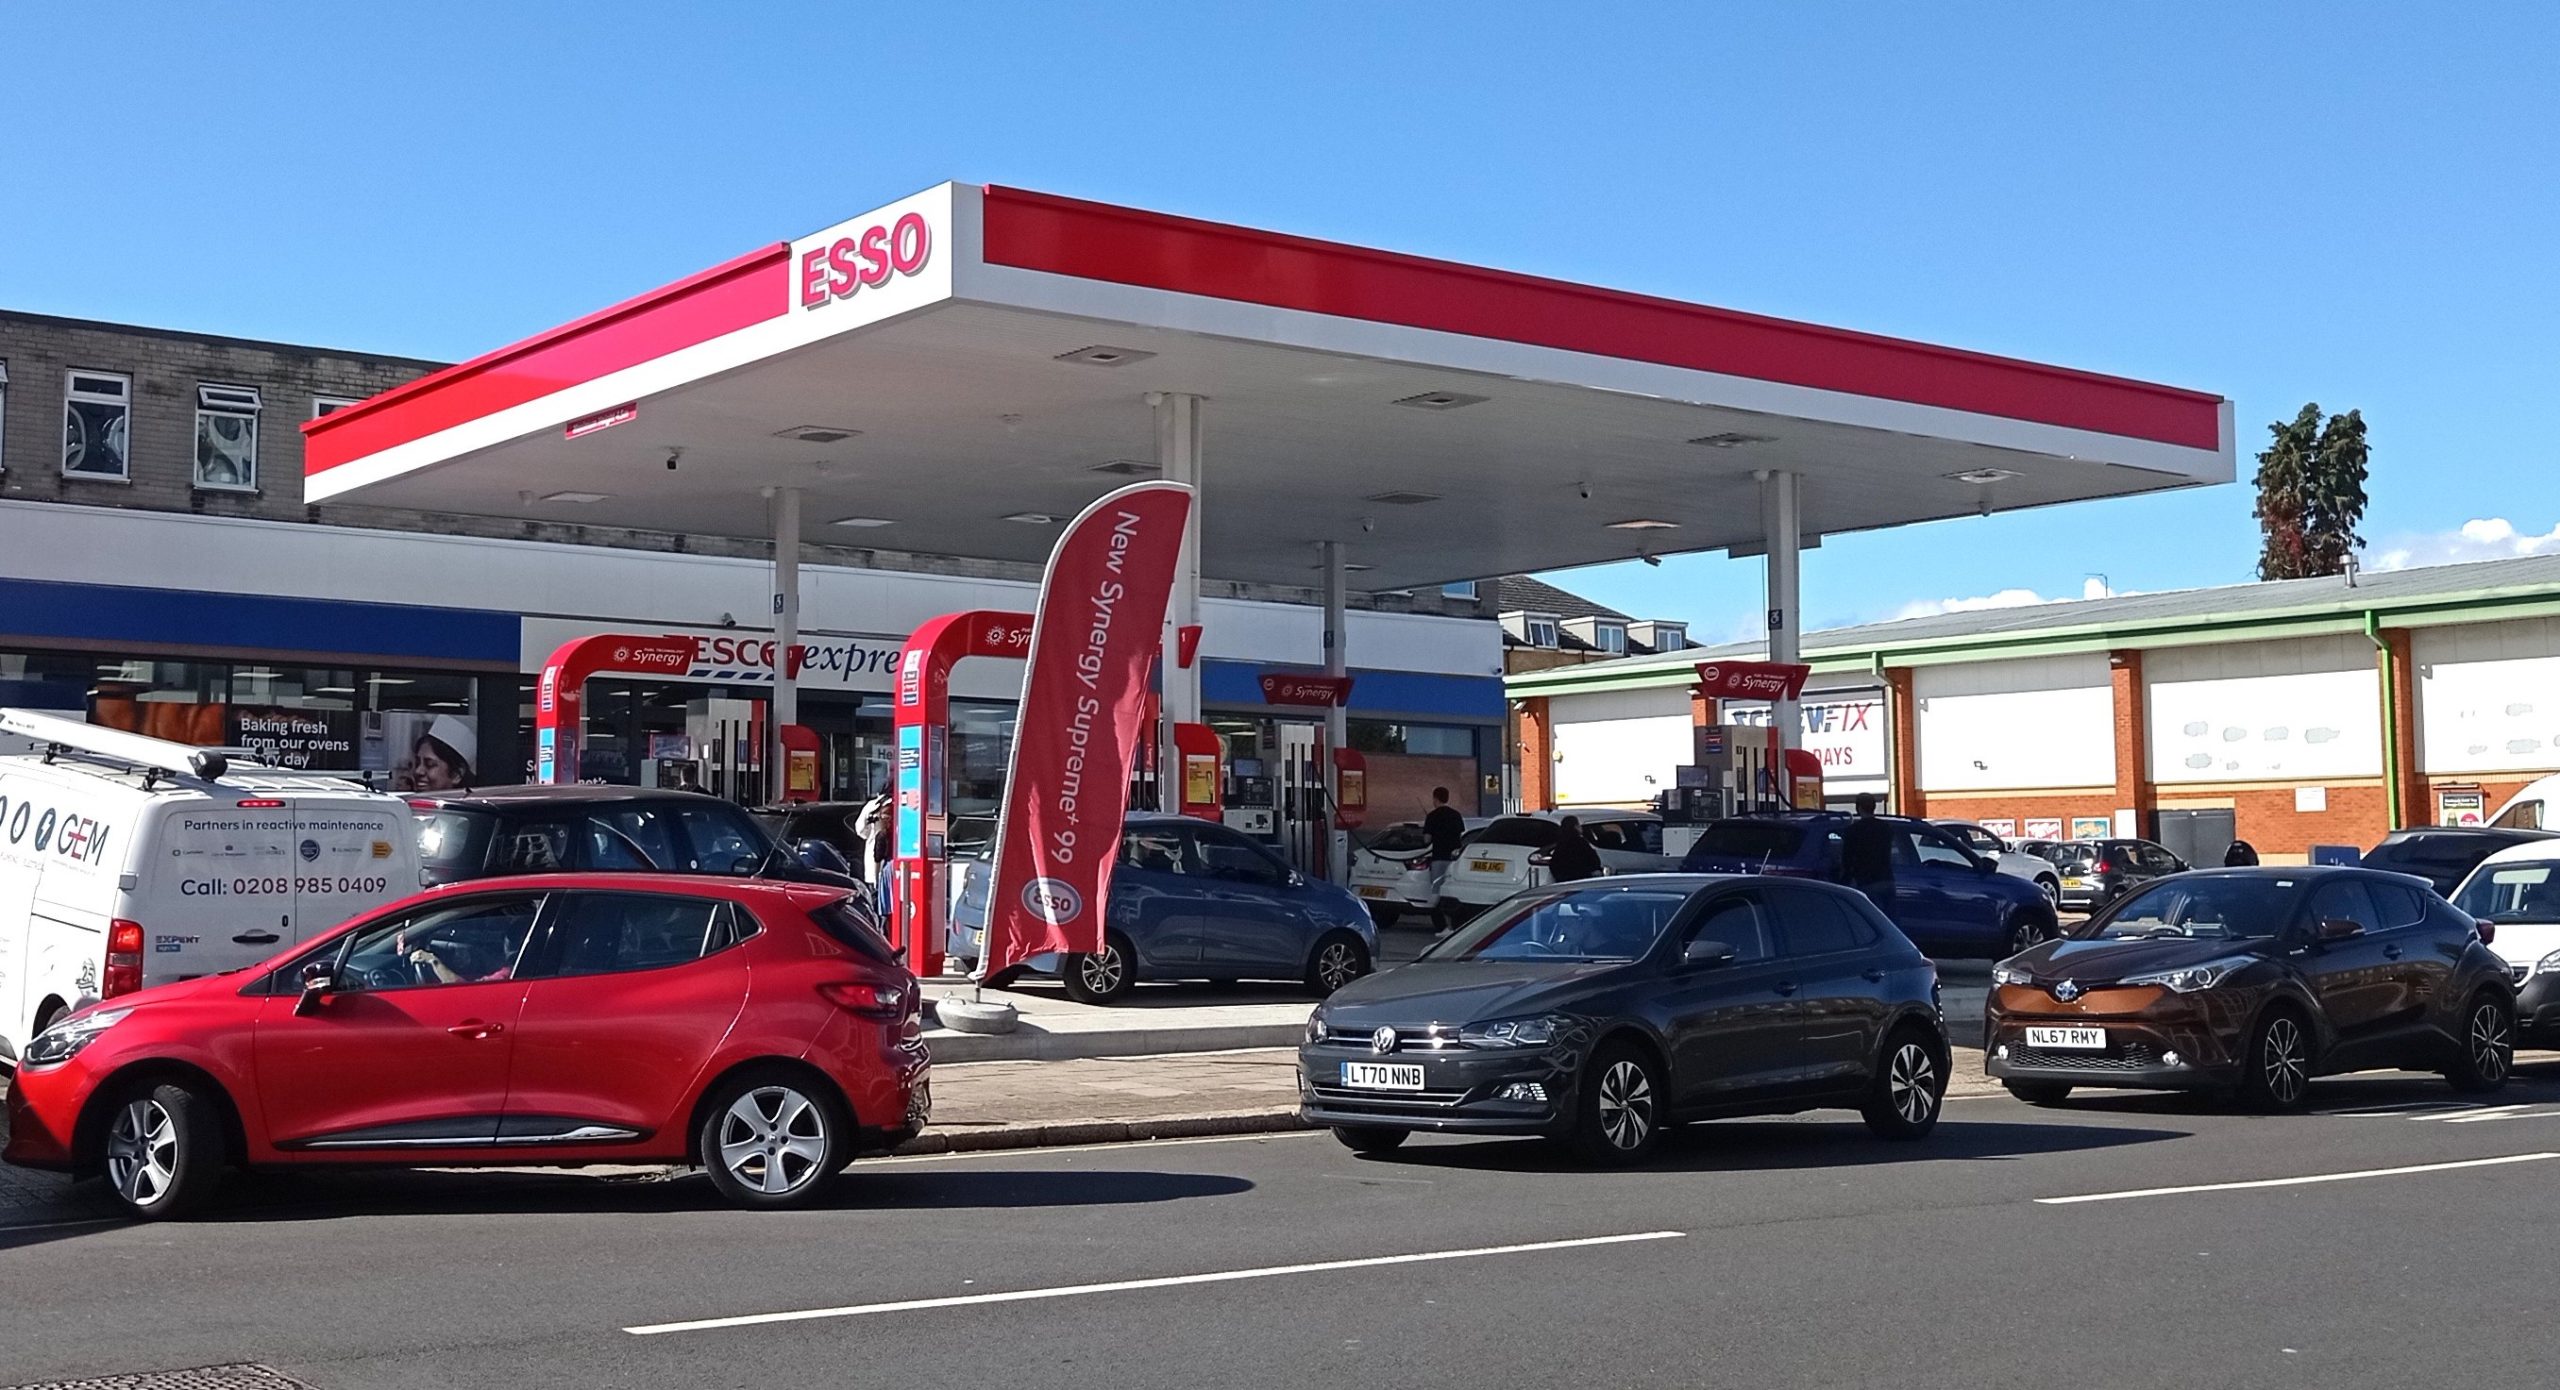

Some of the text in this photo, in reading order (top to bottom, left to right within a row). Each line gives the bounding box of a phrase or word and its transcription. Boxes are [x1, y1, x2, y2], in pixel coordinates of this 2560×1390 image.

[801, 212, 931, 310] ESSO
[1106, 511, 1141, 574] New
[1076, 581, 1124, 690] Synergy
[632, 649, 684, 666] Synergy
[1742, 675, 1785, 692] Synergy
[1295, 686, 1333, 700] Synergy
[241, 718, 328, 735] Baking fresh
[241, 734, 349, 751] from our ovens
[284, 753, 309, 768] day
[184, 820, 384, 831] Partners in reactive maintenance
[58, 814, 109, 866] GEM
[1051, 830, 1076, 864] 99
[181, 877, 387, 895] Call: 0208 985 0409
[2032, 1029, 2098, 1044] NL67 RMY
[1351, 1065, 1421, 1086] LT70 NNB
